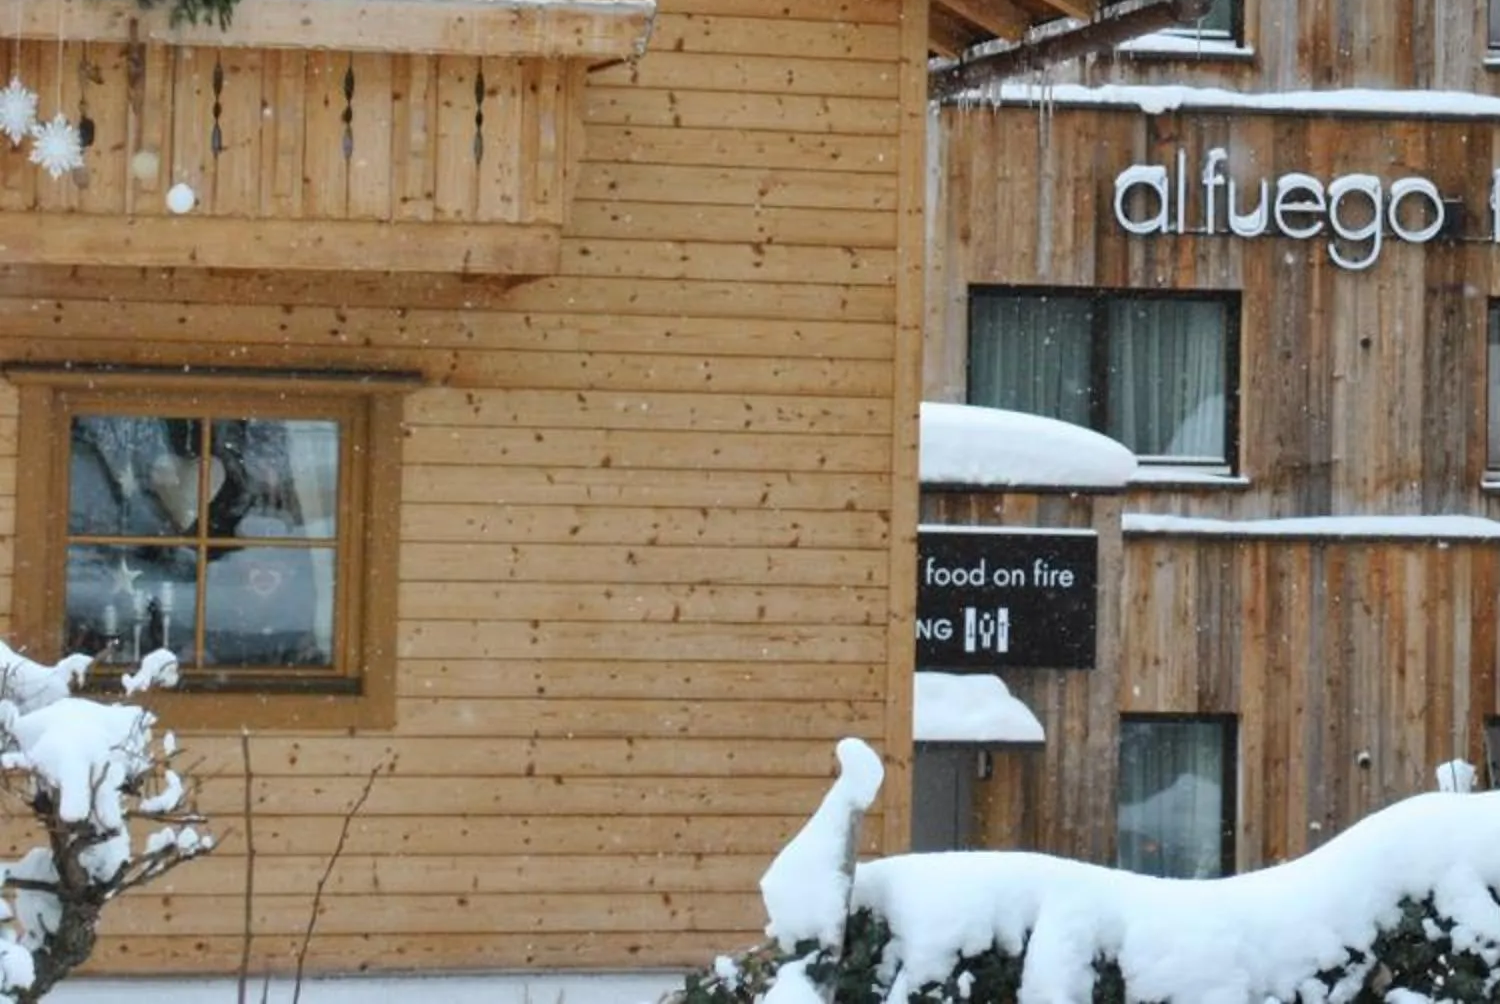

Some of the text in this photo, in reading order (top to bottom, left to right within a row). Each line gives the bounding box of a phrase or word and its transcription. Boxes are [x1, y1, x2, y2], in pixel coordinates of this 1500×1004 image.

[925, 557, 1075, 587] food on fire
